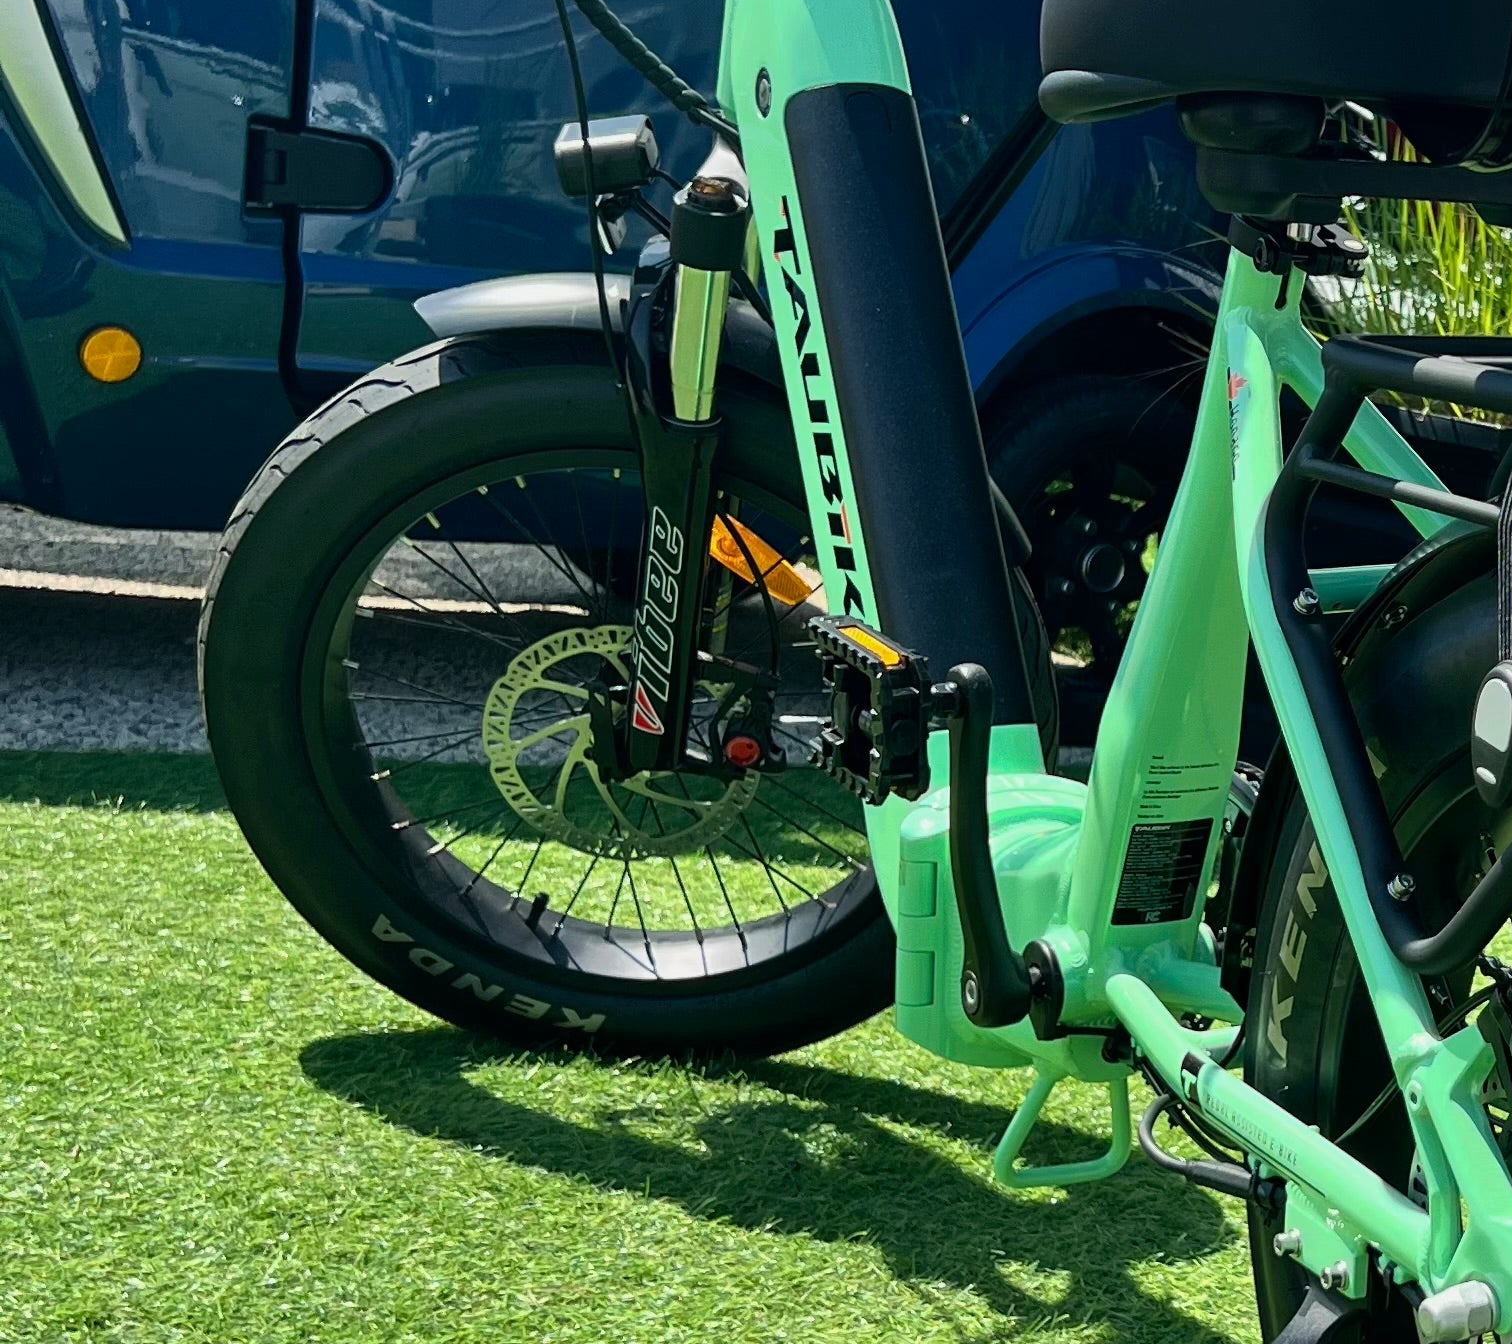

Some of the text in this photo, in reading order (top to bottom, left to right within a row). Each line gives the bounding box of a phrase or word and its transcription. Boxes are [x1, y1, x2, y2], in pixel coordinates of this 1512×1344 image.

[773, 195, 865, 618] TAUBIK
[371, 913, 606, 1033] KENDA
[1267, 840, 1328, 1063] KEN
[1206, 1093, 1229, 1119] PEDAL
